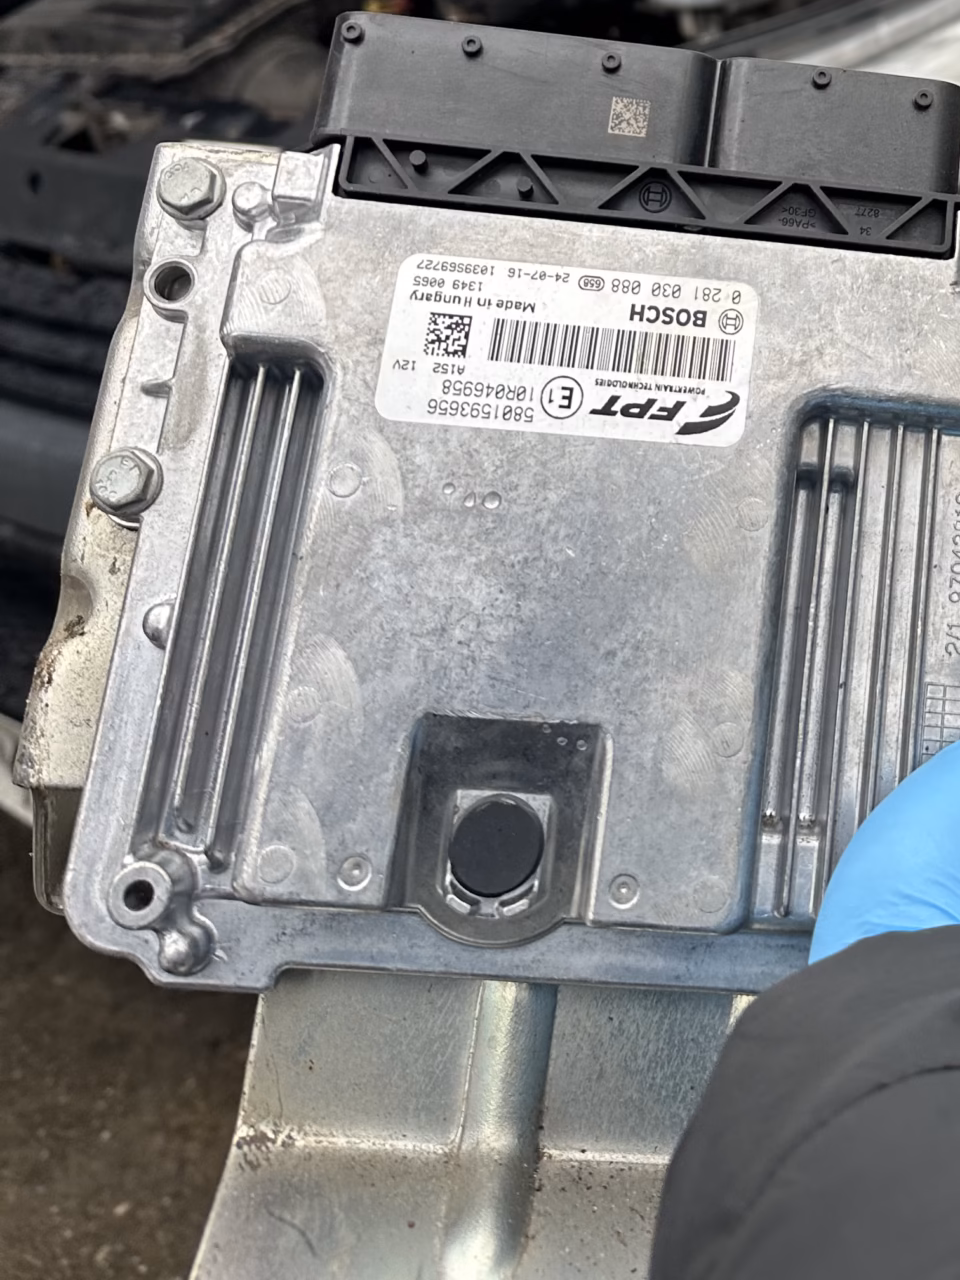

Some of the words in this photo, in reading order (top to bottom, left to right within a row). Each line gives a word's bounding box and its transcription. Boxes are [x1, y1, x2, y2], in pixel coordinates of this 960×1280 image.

[412, 275, 445, 288] 0065
[507, 267, 571, 284] 24-07-16
[583, 277, 602, 289] 658
[452, 279, 483, 292] 1349
[611, 278, 642, 295] 088
[651, 281, 682, 299] 030
[409, 289, 473, 308] Hungary
[693, 285, 722, 303] 281
[731, 289, 742, 305] 0
[477, 297, 492, 310] in
[495, 298, 536, 314] Made
[629, 303, 708, 328] BOSCH
[392, 359, 417, 372] 12V
[432, 362, 466, 376] A152
[441, 379, 534, 403] 10R046958
[594, 377, 653, 392] TECHNOLOGIES
[654, 383, 706, 396] POWERTRAIN
[427, 398, 535, 423] 5801593656
[589, 395, 687, 422] FPT
